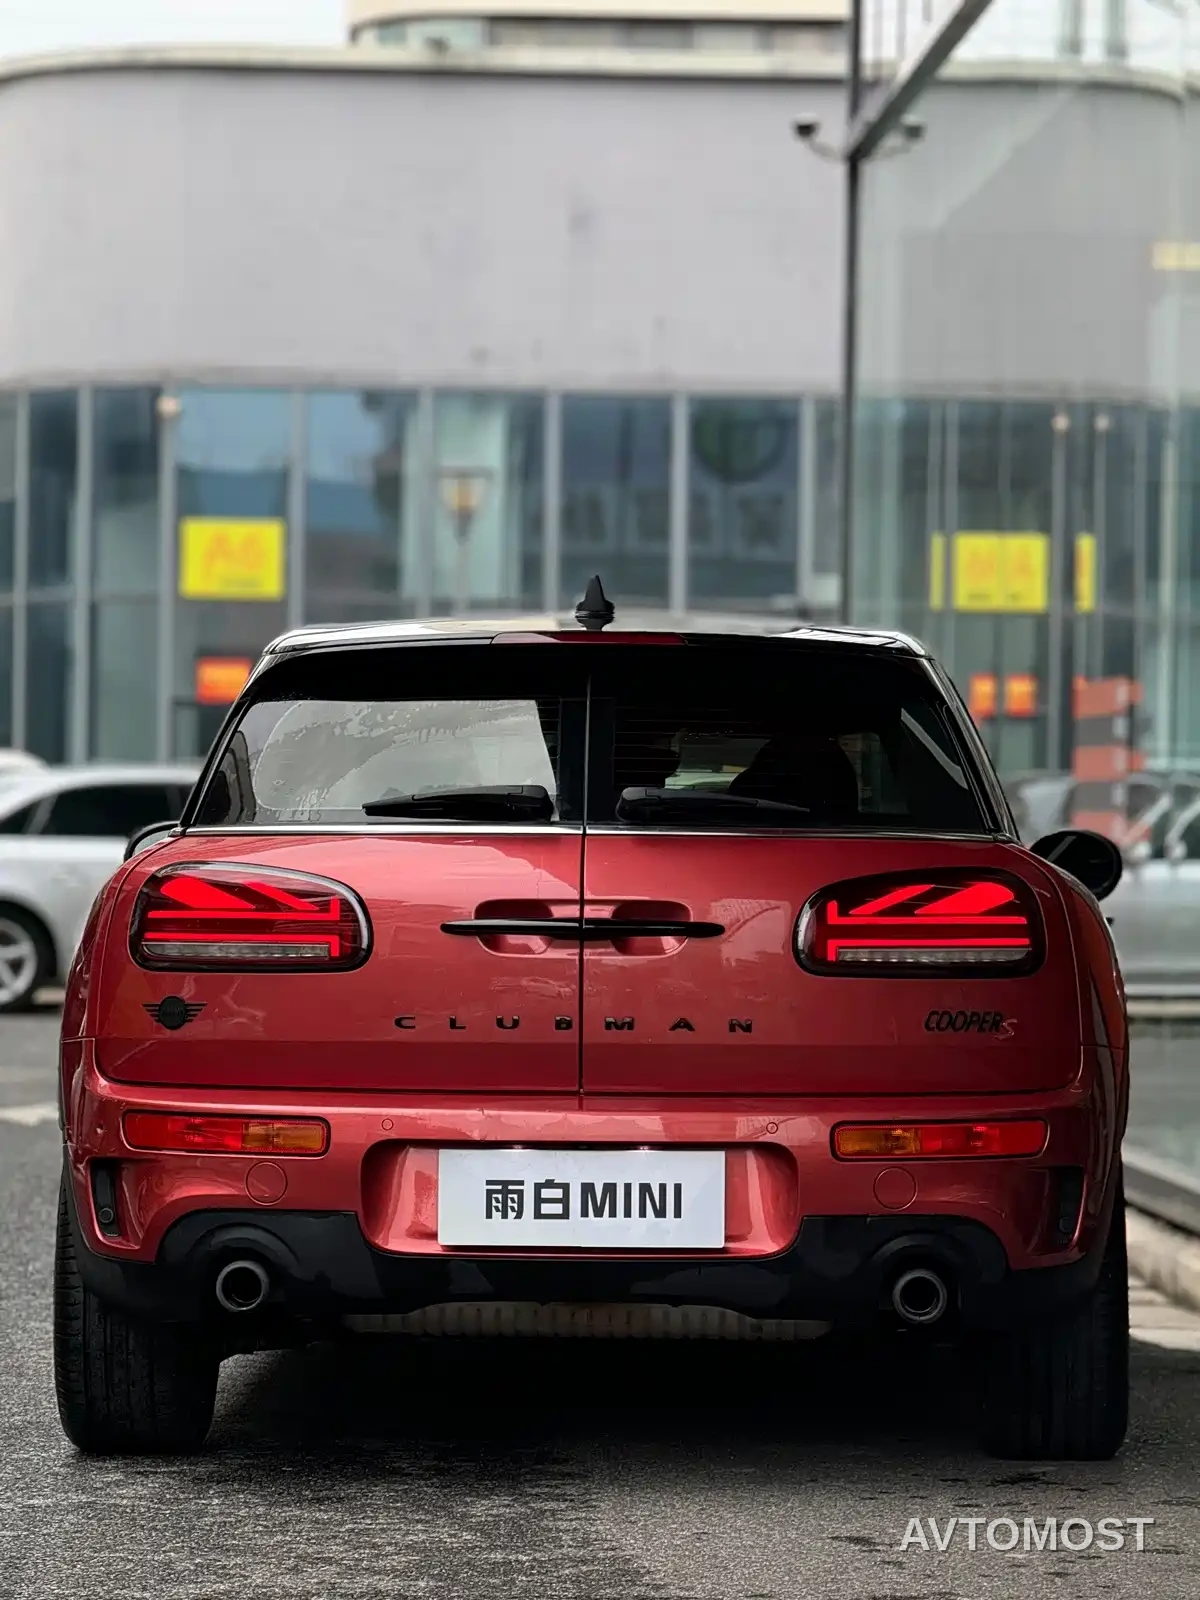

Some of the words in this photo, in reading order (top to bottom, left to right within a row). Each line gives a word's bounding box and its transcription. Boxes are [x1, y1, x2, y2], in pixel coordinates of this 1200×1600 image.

[394, 1015, 753, 1033] CLUBMAN
[923, 1010, 1003, 1033] COOPER
[992, 1018, 1018, 1040] S
